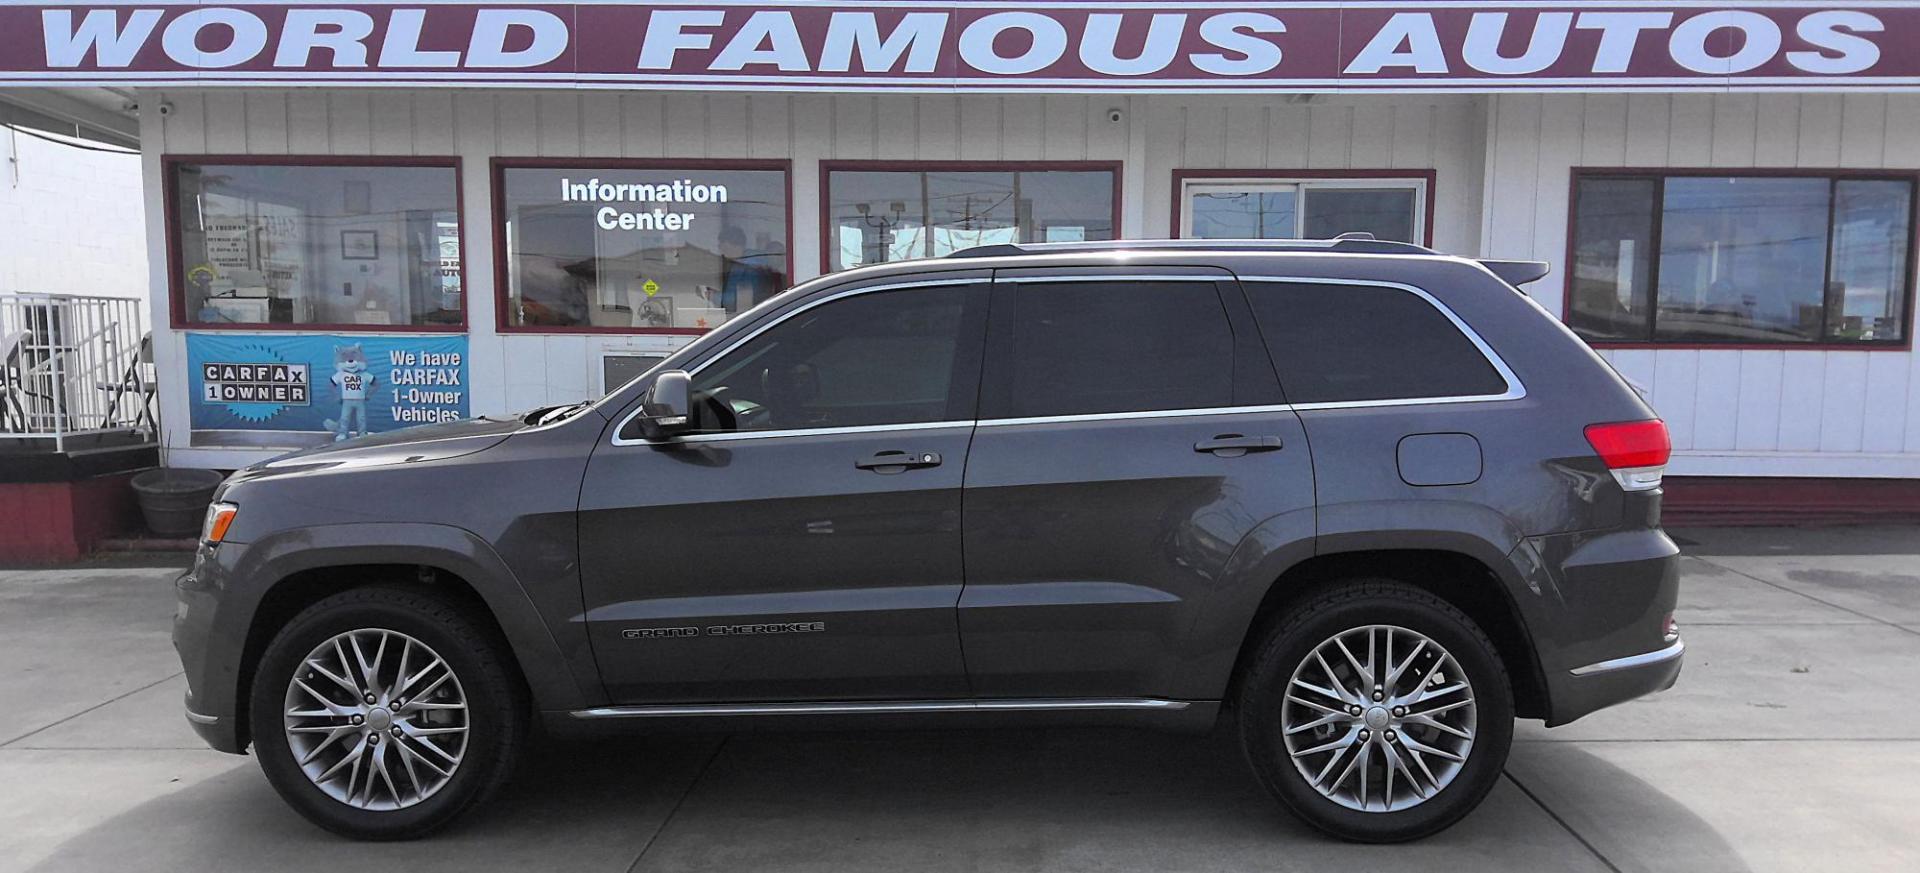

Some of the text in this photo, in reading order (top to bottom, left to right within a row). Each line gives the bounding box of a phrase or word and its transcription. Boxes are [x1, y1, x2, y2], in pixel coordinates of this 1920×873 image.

[41, 7, 1885, 76] WORLD FAMOUS AUTOS
[561, 178, 728, 203] Information
[596, 207, 695, 231] Center
[390, 350, 461, 366] We have
[206, 366, 303, 382] CARFAX
[390, 368, 460, 385] CARFAX
[224, 386, 304, 400] OWNER
[345, 383, 362, 391] FOX
[392, 387, 461, 404] 1-Owner
[391, 405, 460, 422] Vehicles
[622, 621, 825, 639] GRAND CHEROKEE
